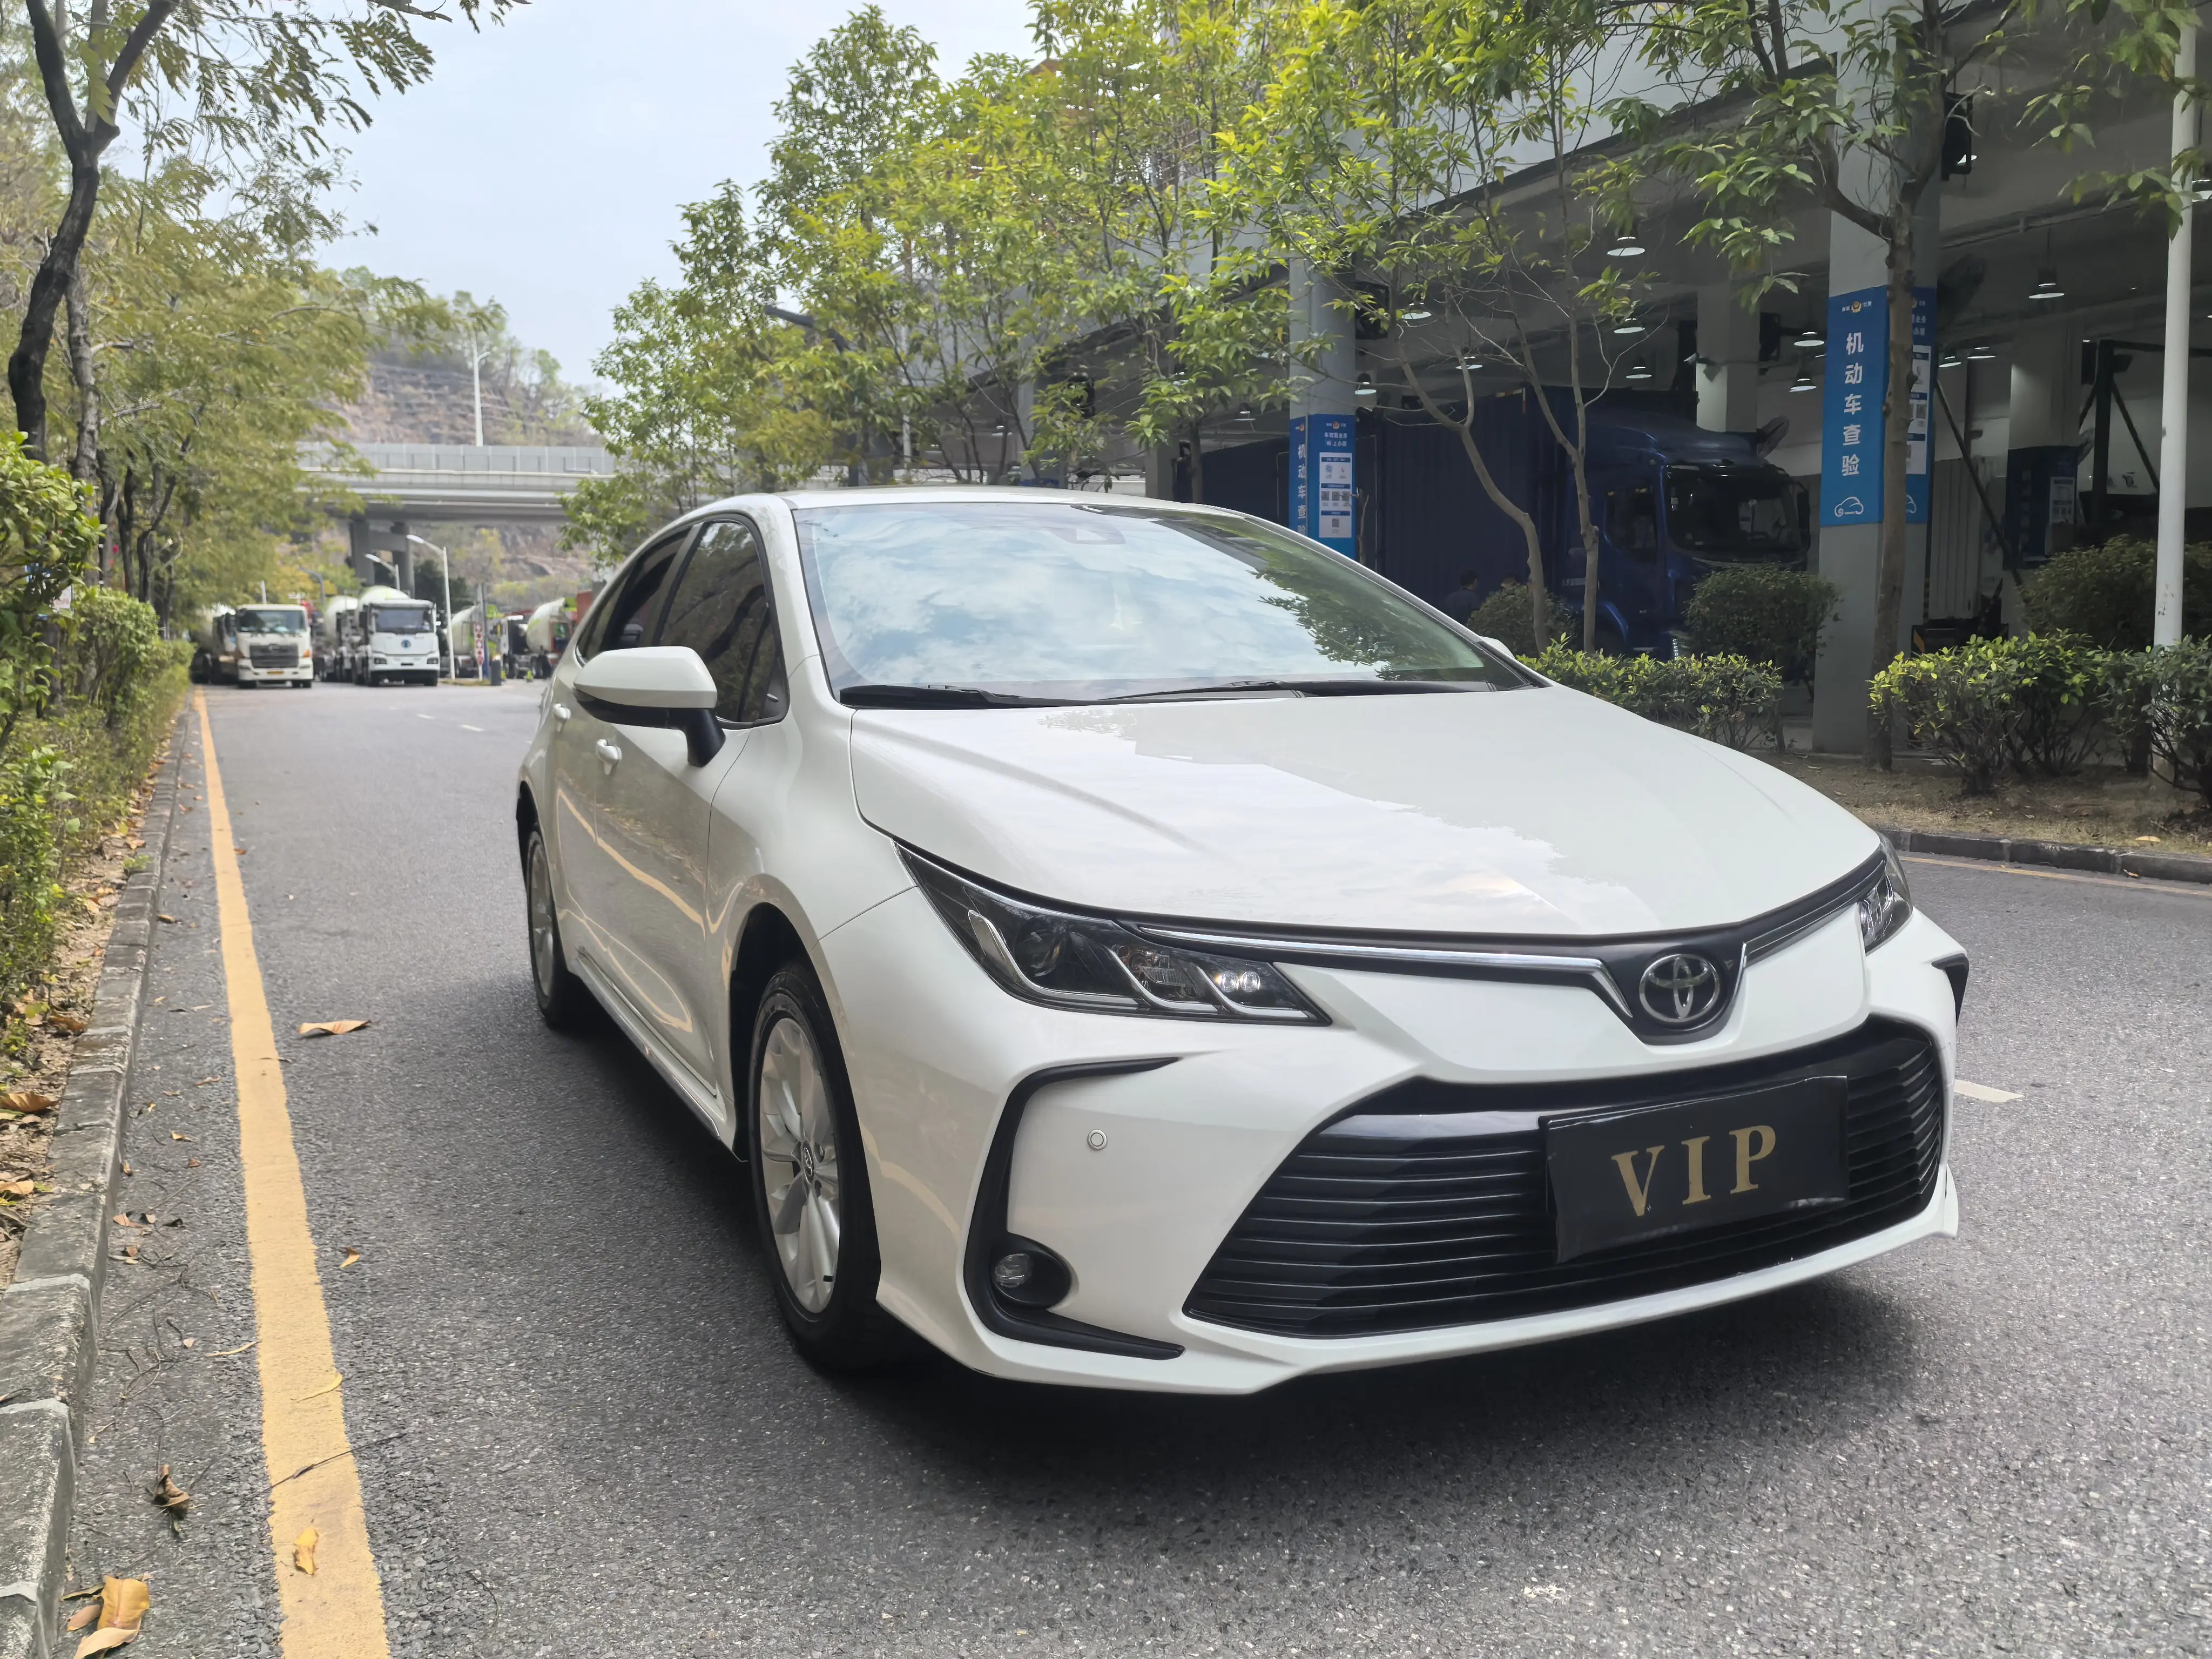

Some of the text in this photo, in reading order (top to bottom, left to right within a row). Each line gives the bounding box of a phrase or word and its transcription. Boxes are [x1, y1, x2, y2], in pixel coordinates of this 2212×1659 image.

[1842, 332, 1864, 476] 机动车查验
[1611, 1125, 1776, 1216] VIP
